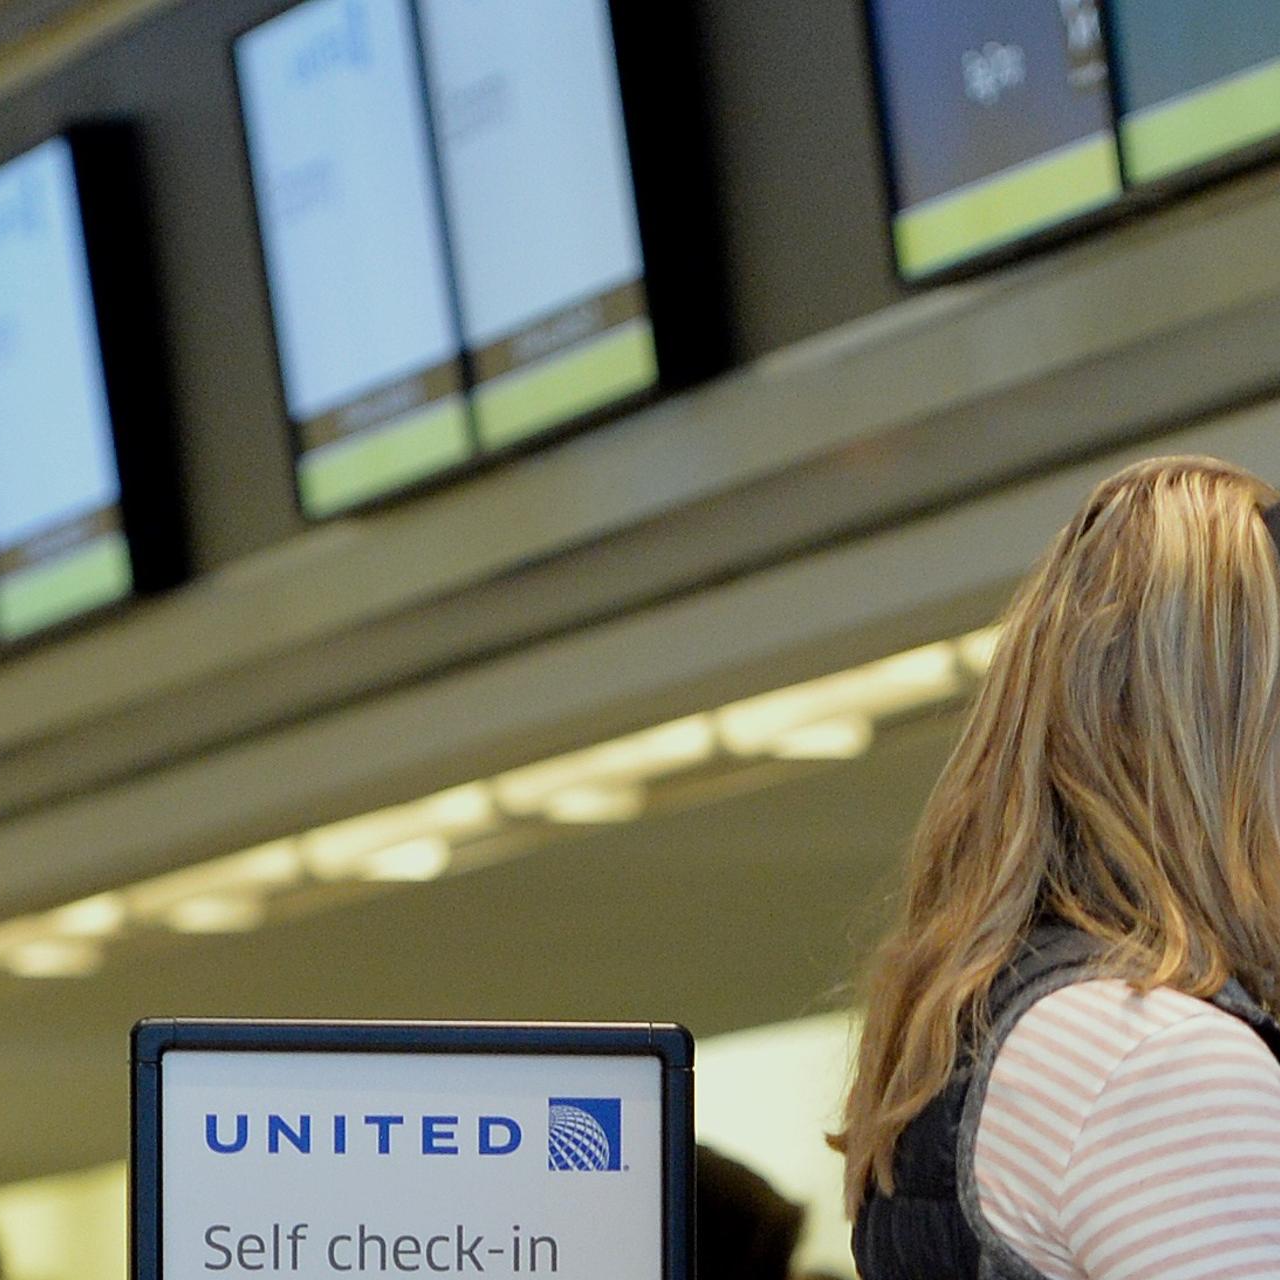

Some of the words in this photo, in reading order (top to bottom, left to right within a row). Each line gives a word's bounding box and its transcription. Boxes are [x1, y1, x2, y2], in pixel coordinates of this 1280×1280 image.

[205, 1114, 523, 1156] UNITED
[204, 1224, 309, 1272] Self
[328, 1224, 559, 1273] check-in
